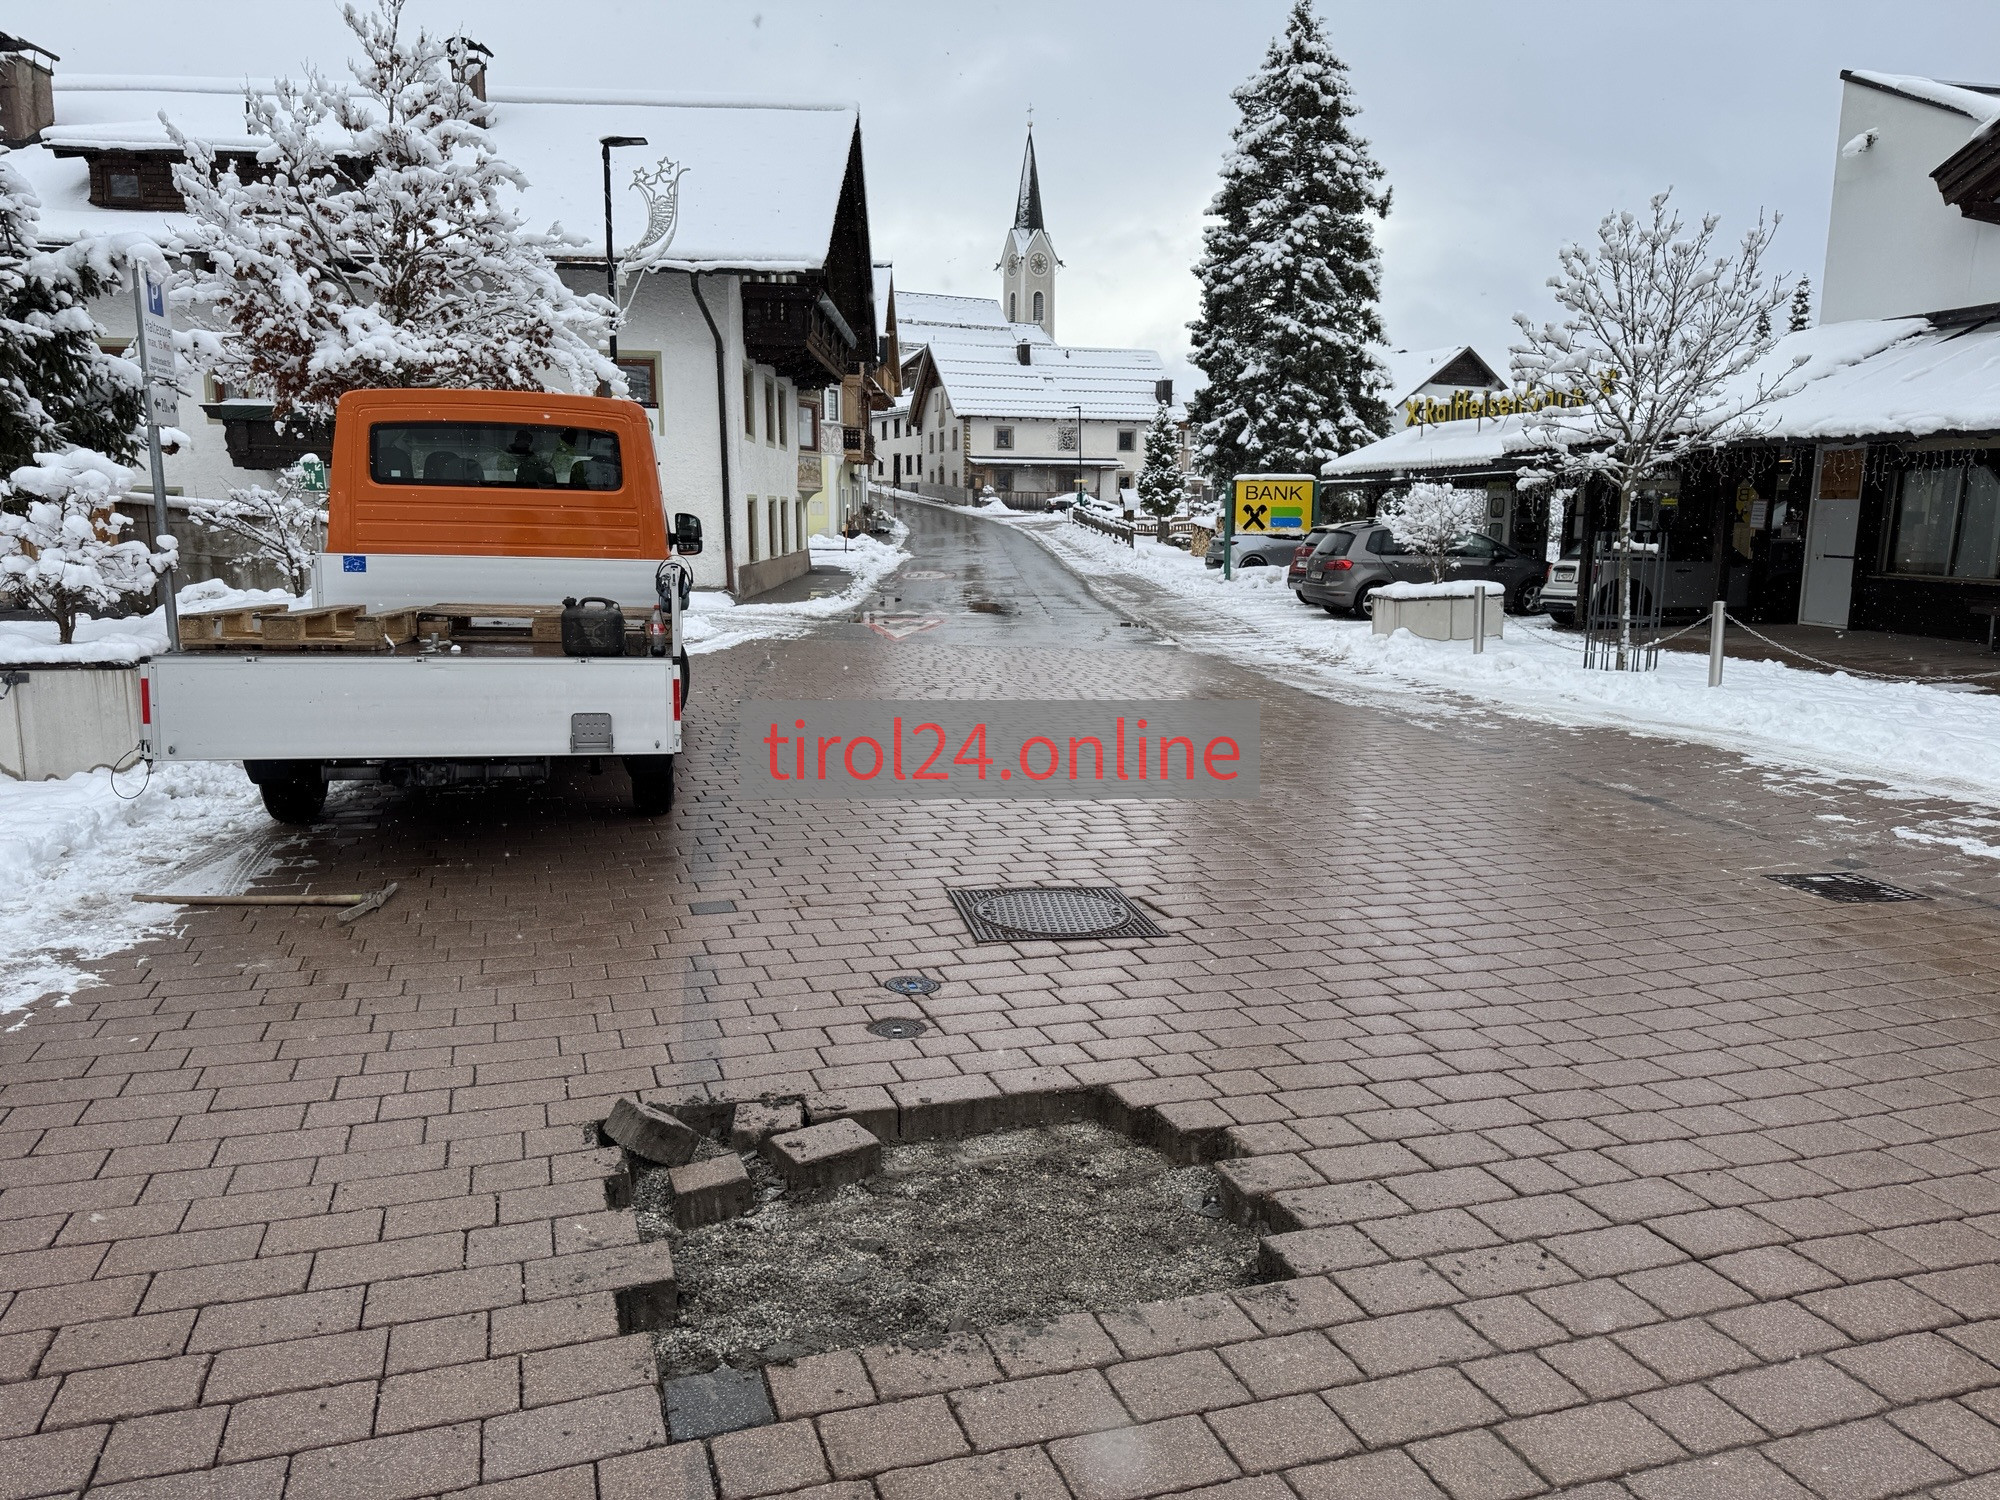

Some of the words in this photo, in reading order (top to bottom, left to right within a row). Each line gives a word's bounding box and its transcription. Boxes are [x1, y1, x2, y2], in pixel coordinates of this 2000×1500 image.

[151, 284, 159, 310] P
[145, 318, 172, 339] Haltezone
[1246, 486, 1303, 501] BANK
